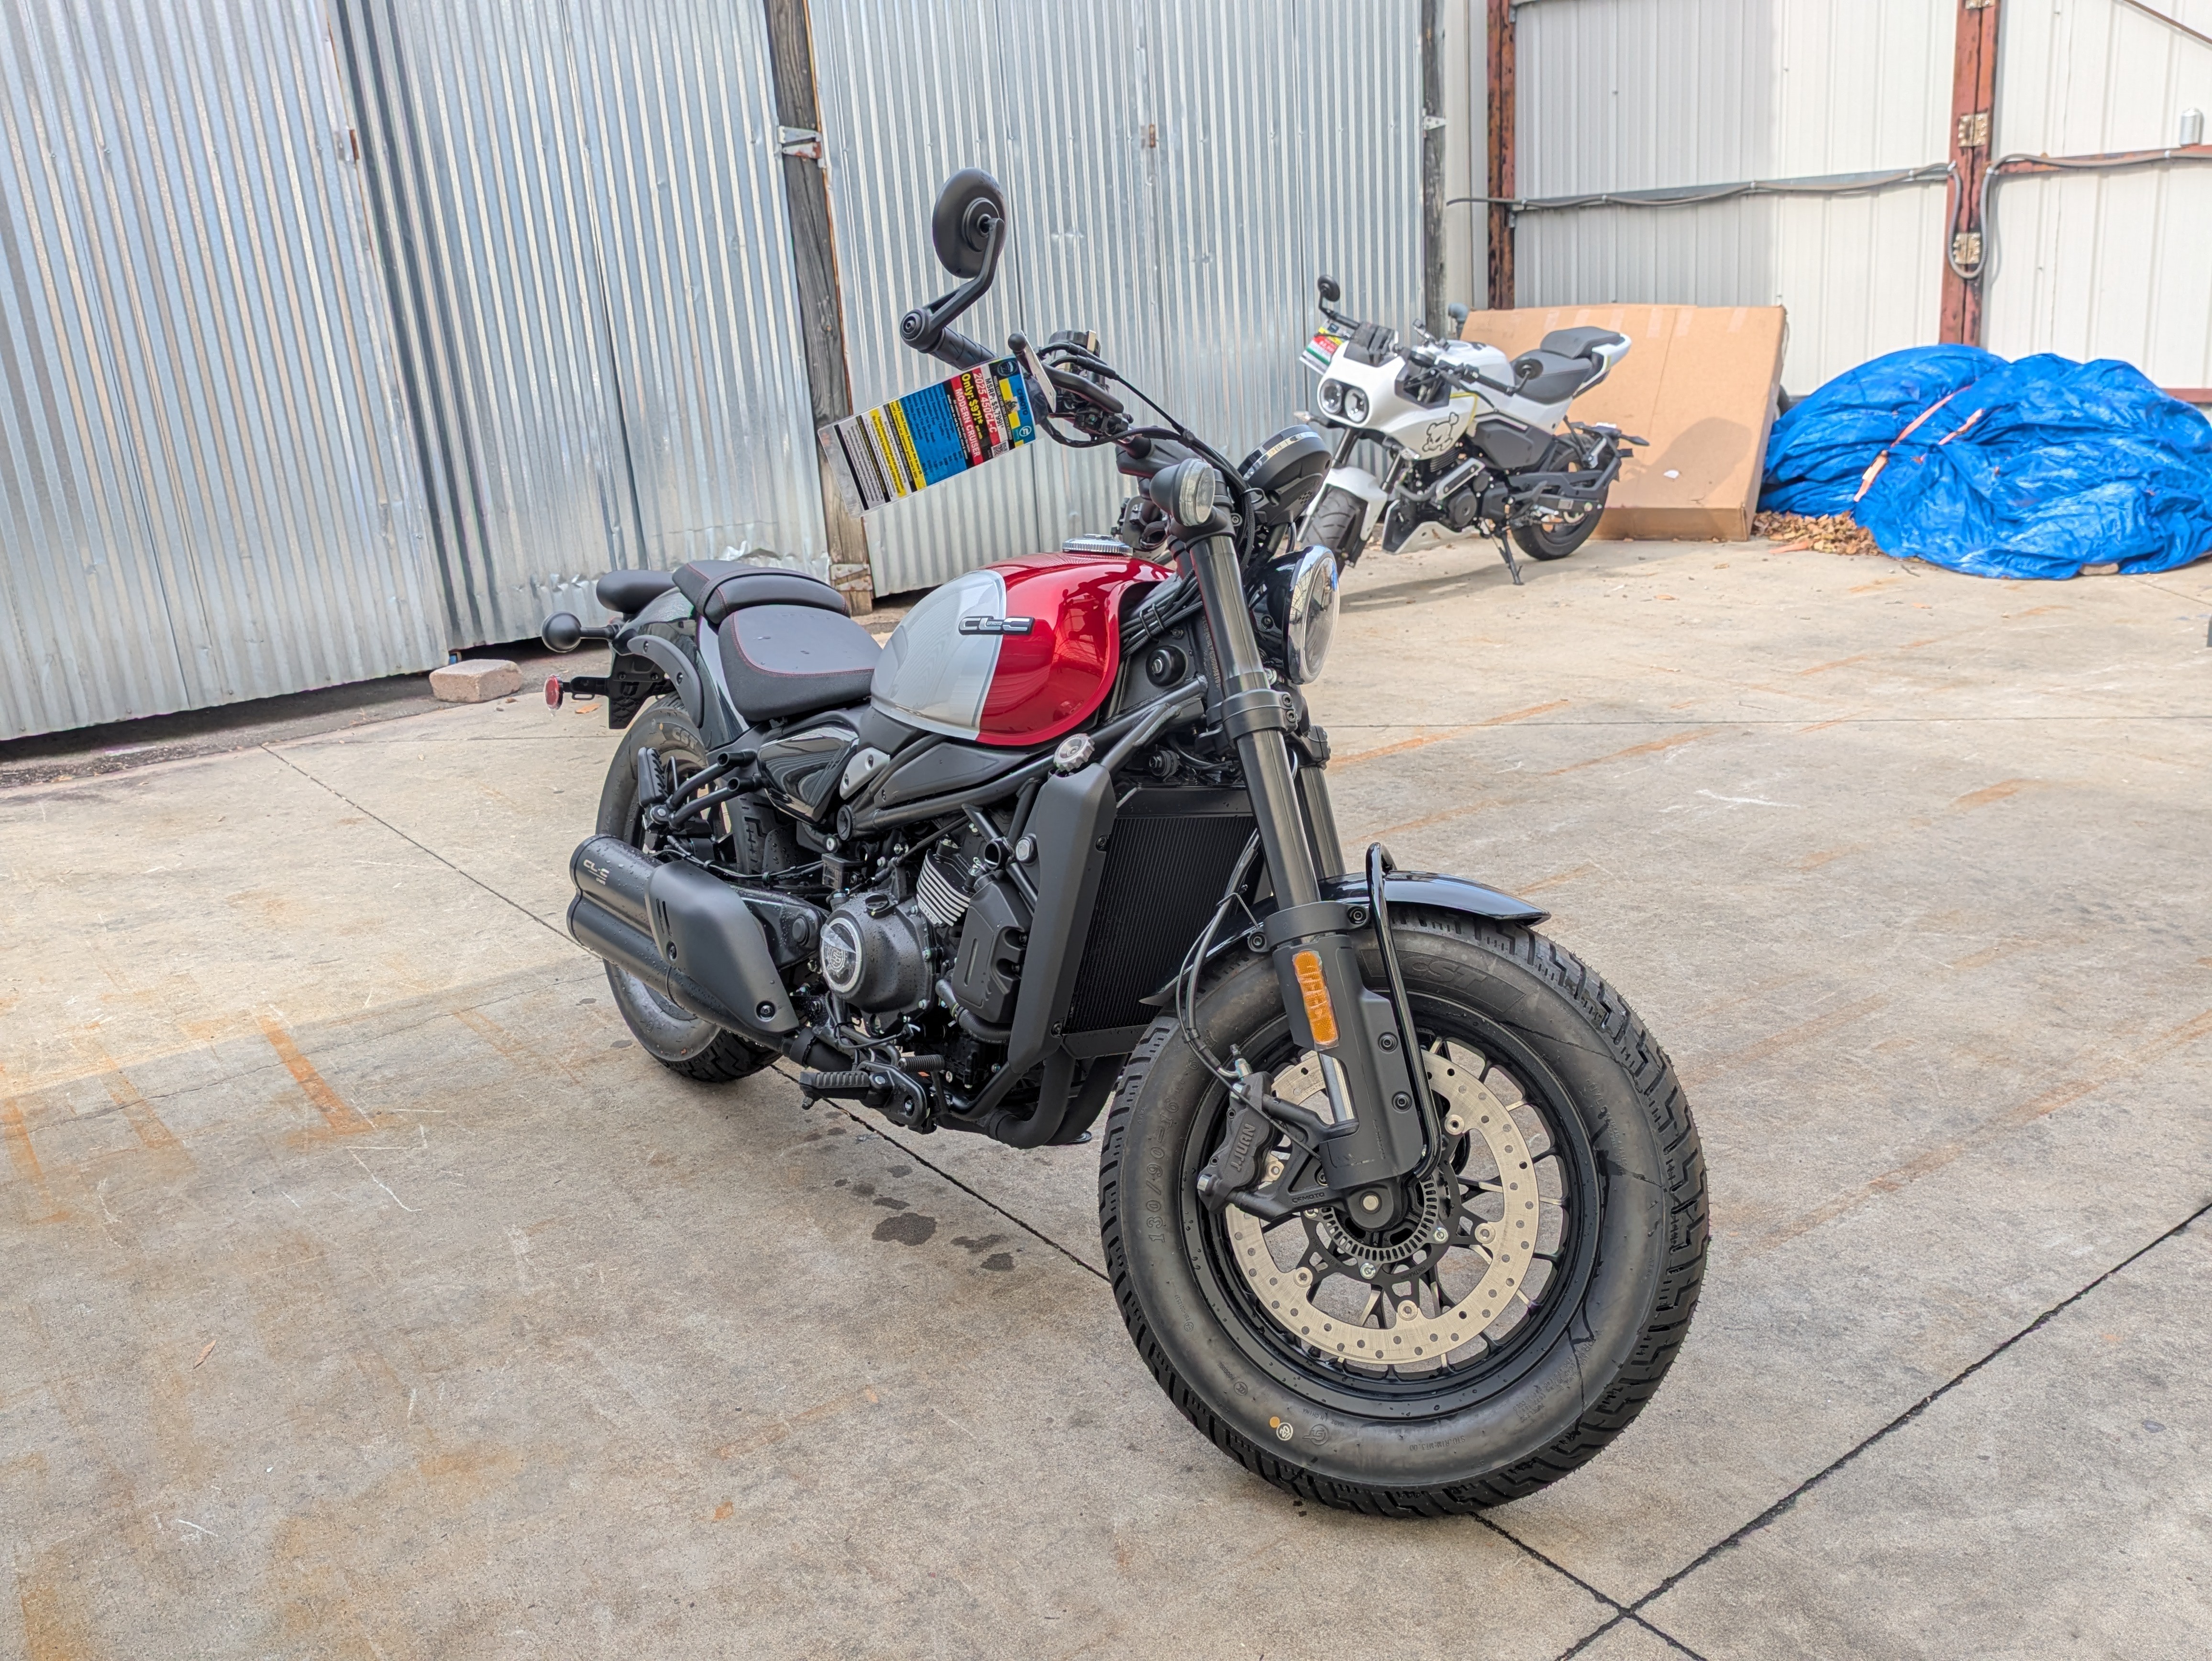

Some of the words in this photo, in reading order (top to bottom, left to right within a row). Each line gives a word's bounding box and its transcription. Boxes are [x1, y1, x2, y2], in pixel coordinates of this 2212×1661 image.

[962, 373, 975, 399] Only:
[985, 378, 996, 400] MSRP:
[973, 372, 984, 396] 2025
[981, 396, 996, 433] 450CL-C
[1018, 389, 1028, 415] CFMOTO
[956, 388, 971, 423] MODERN
[966, 424, 980, 457] CRUISER
[672, 727, 698, 753] CST
[1401, 956, 1489, 990] CST
[1231, 1122, 1256, 1196] J.JUAN
[1291, 1192, 1325, 1203] CFMOTO
[1301, 1408, 1319, 1418] CHINA
